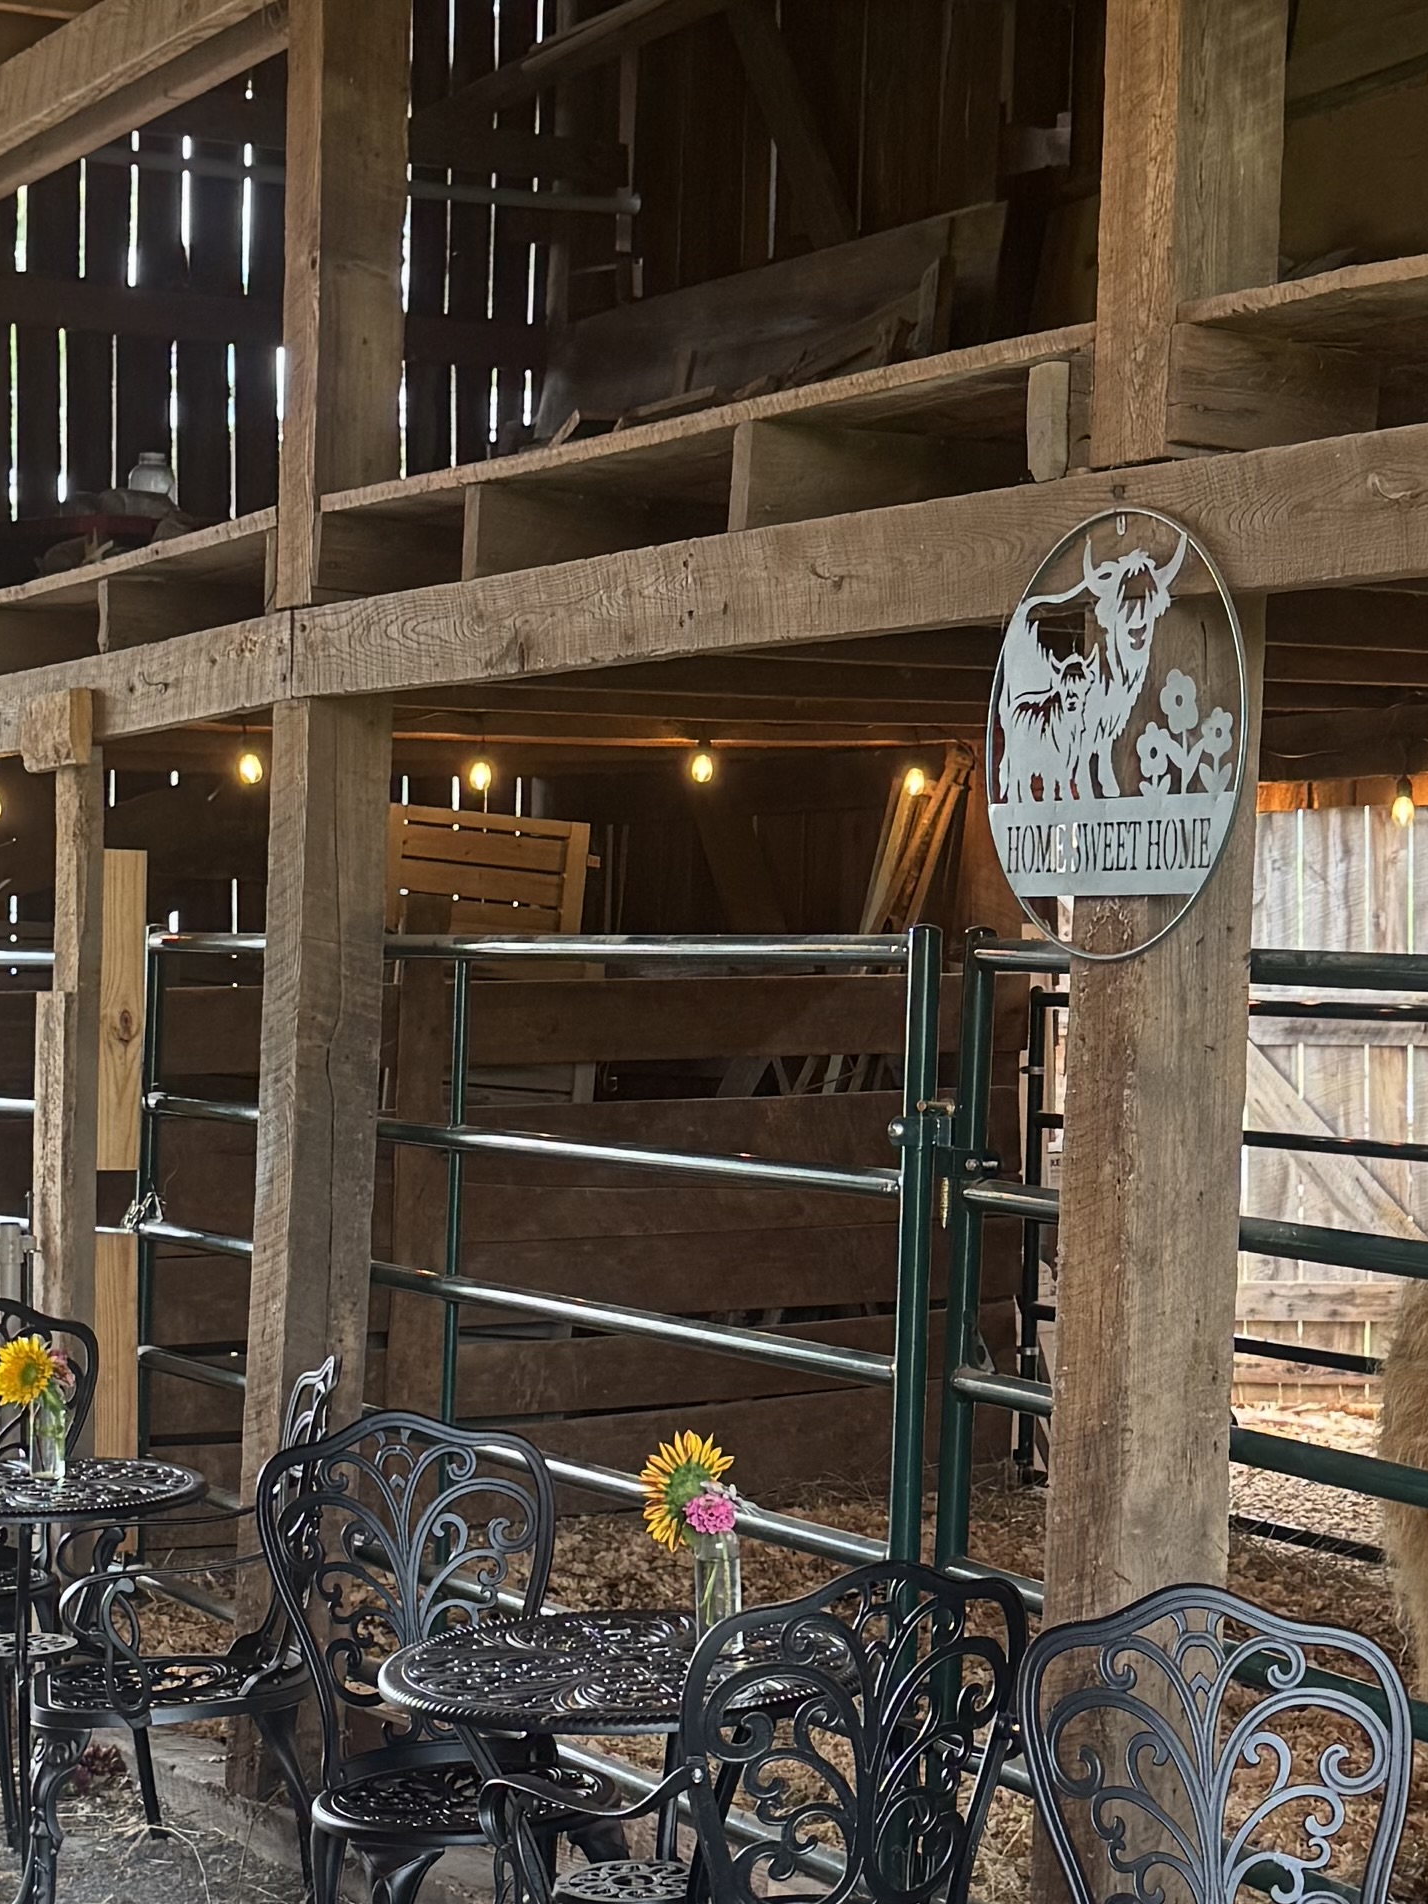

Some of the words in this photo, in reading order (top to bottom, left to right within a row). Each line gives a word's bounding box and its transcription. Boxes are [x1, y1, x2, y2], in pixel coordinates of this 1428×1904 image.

[1007, 824, 1067, 874] HOME
[1071, 821, 1142, 873] SWEET
[1146, 817, 1212, 870] HOME
